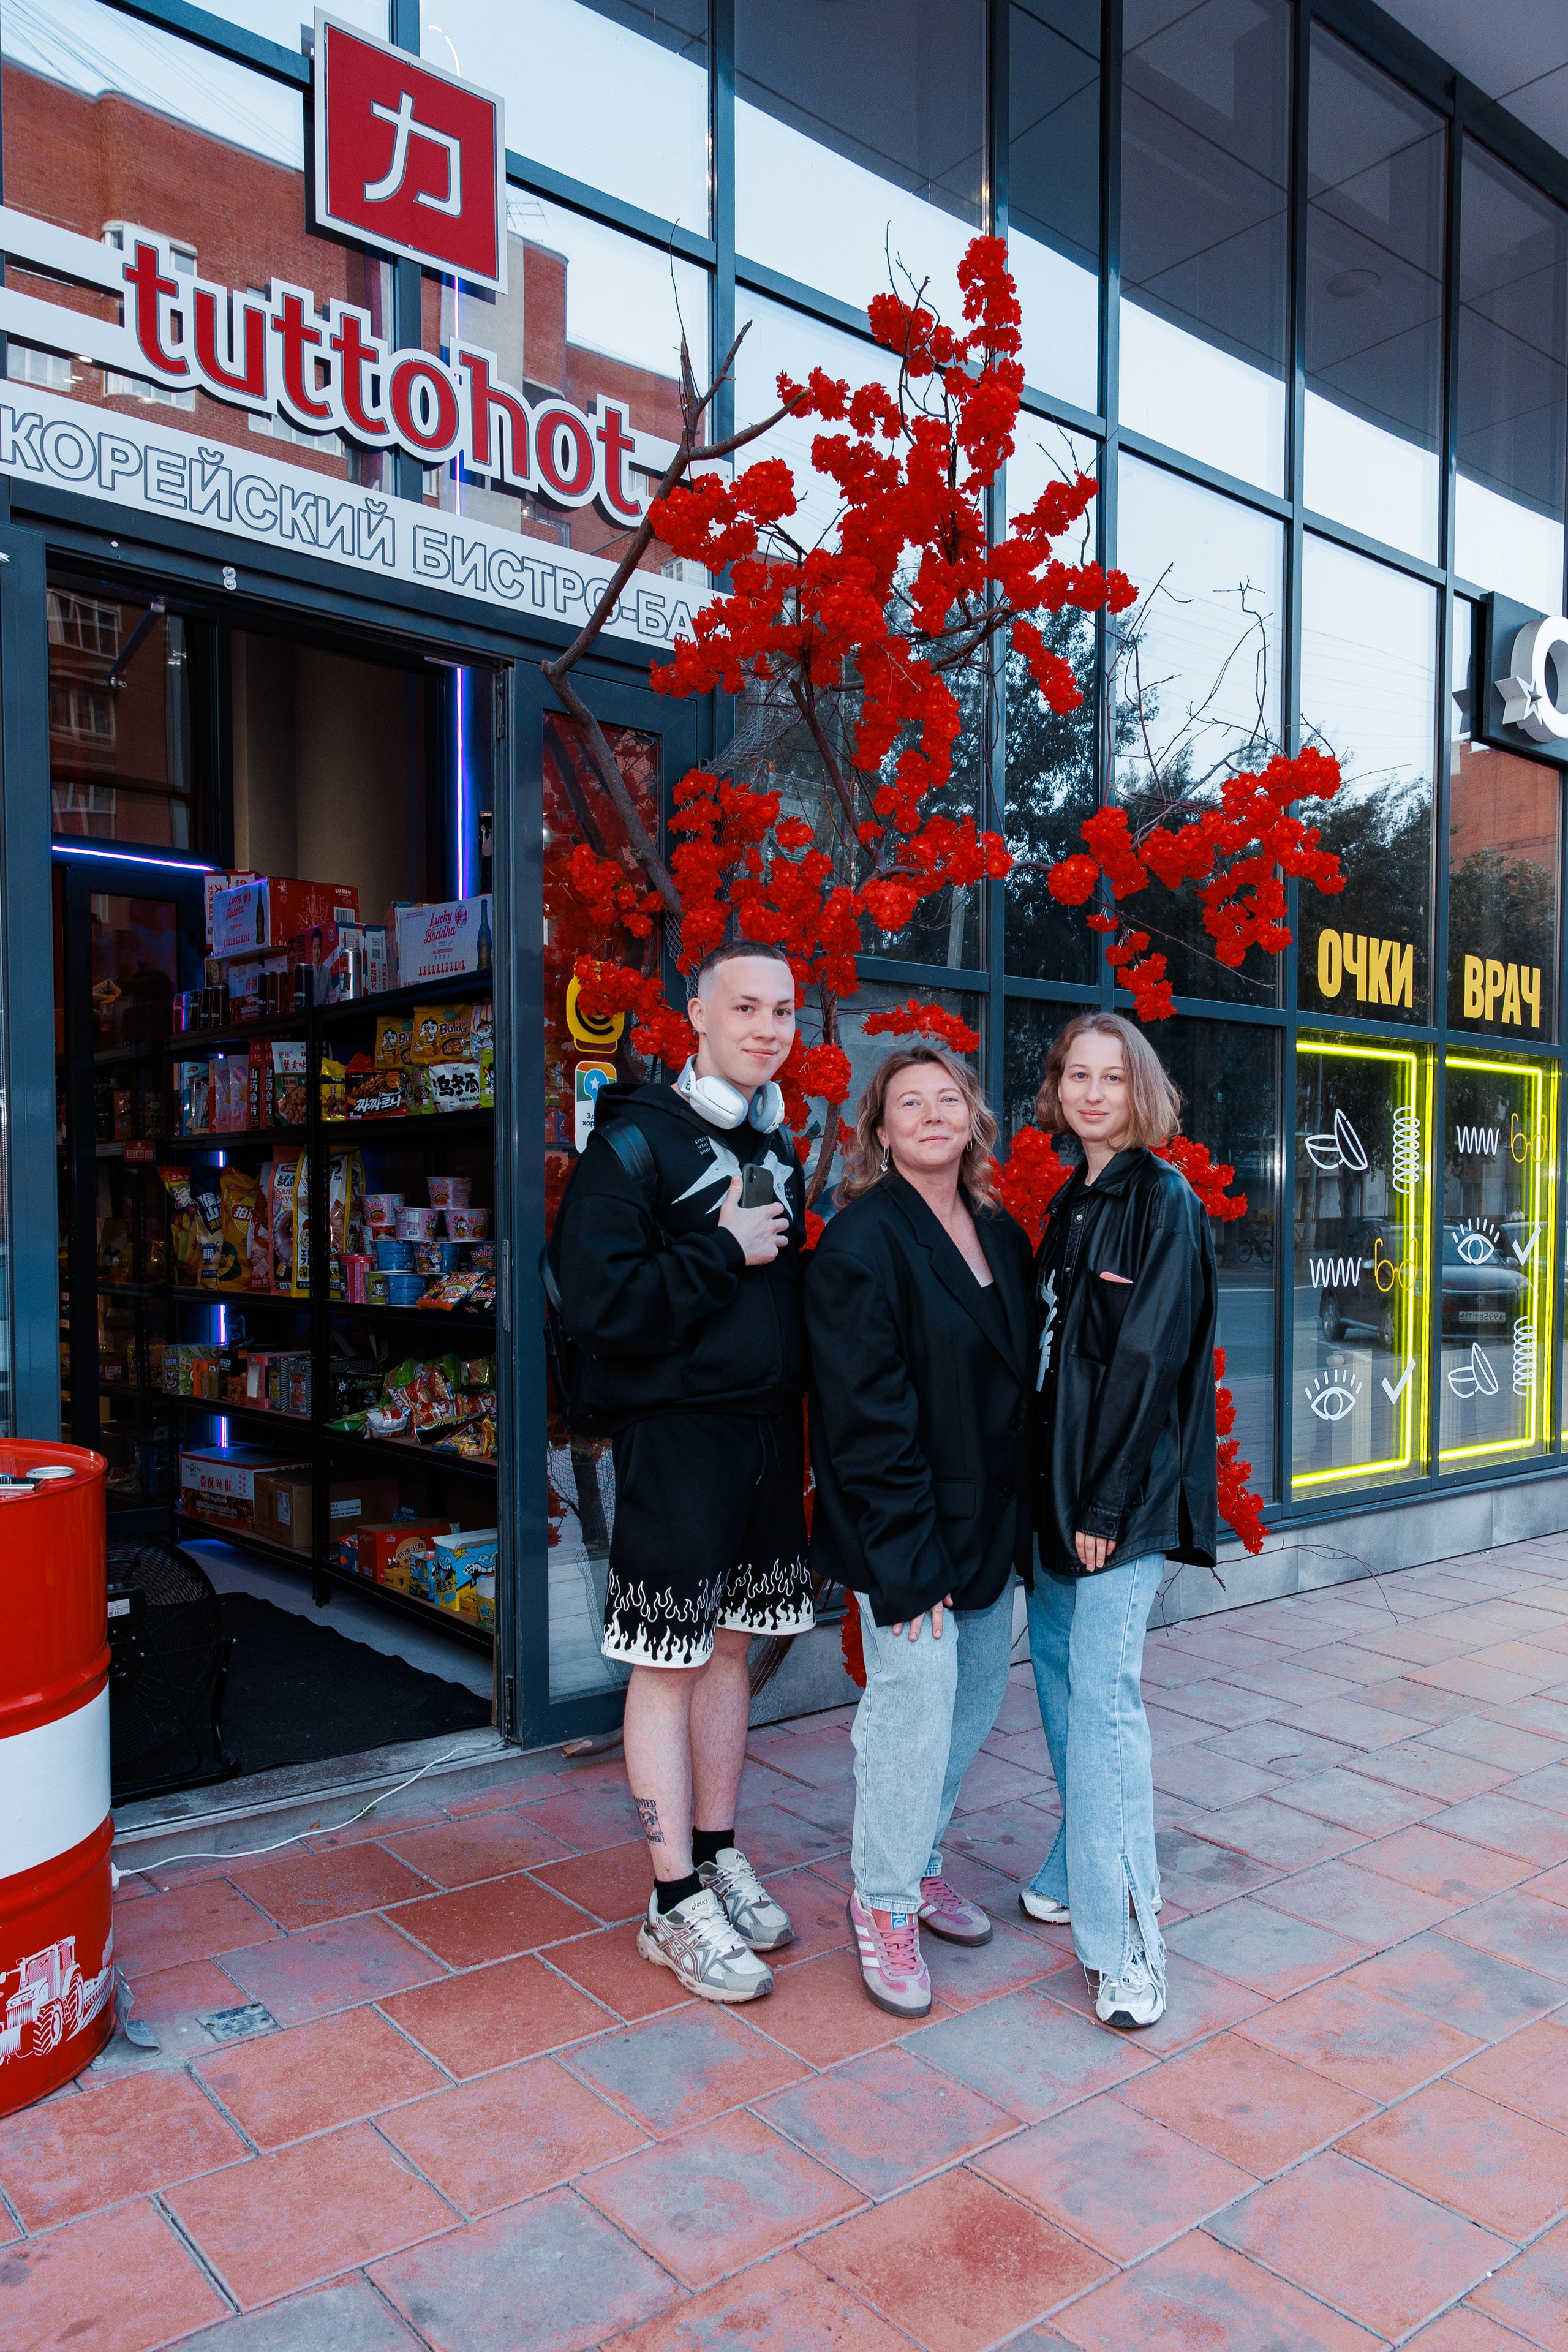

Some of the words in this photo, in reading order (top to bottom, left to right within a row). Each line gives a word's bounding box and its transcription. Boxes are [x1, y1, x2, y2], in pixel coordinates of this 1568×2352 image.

[124, 241, 642, 518] tuttohot
[0, 404, 396, 567] КОРЕЙСКИЙ
[412, 522, 707, 644] БИСТРО-БА
[228, 891, 243, 906] Lucky
[225, 906, 244, 920] Buddha
[429, 910, 453, 927] Lucky
[423, 925, 457, 944] Buddha
[1317, 928, 1414, 1008] ОЧКИ
[1464, 954, 1541, 1029] ВРАЧ
[438, 1022, 469, 1036] Buldak
[398, 1031, 413, 1045] Bul
[249, 1068, 258, 1115] 山药脆片
[353, 1095, 401, 1112] 짜짜로니
[470, 1251, 492, 1261] Buldak
[449, 1276, 475, 1286] Buldak
[200, 1474, 232, 1493] 香酥辣椒
[696, 1899, 708, 1907] asics
